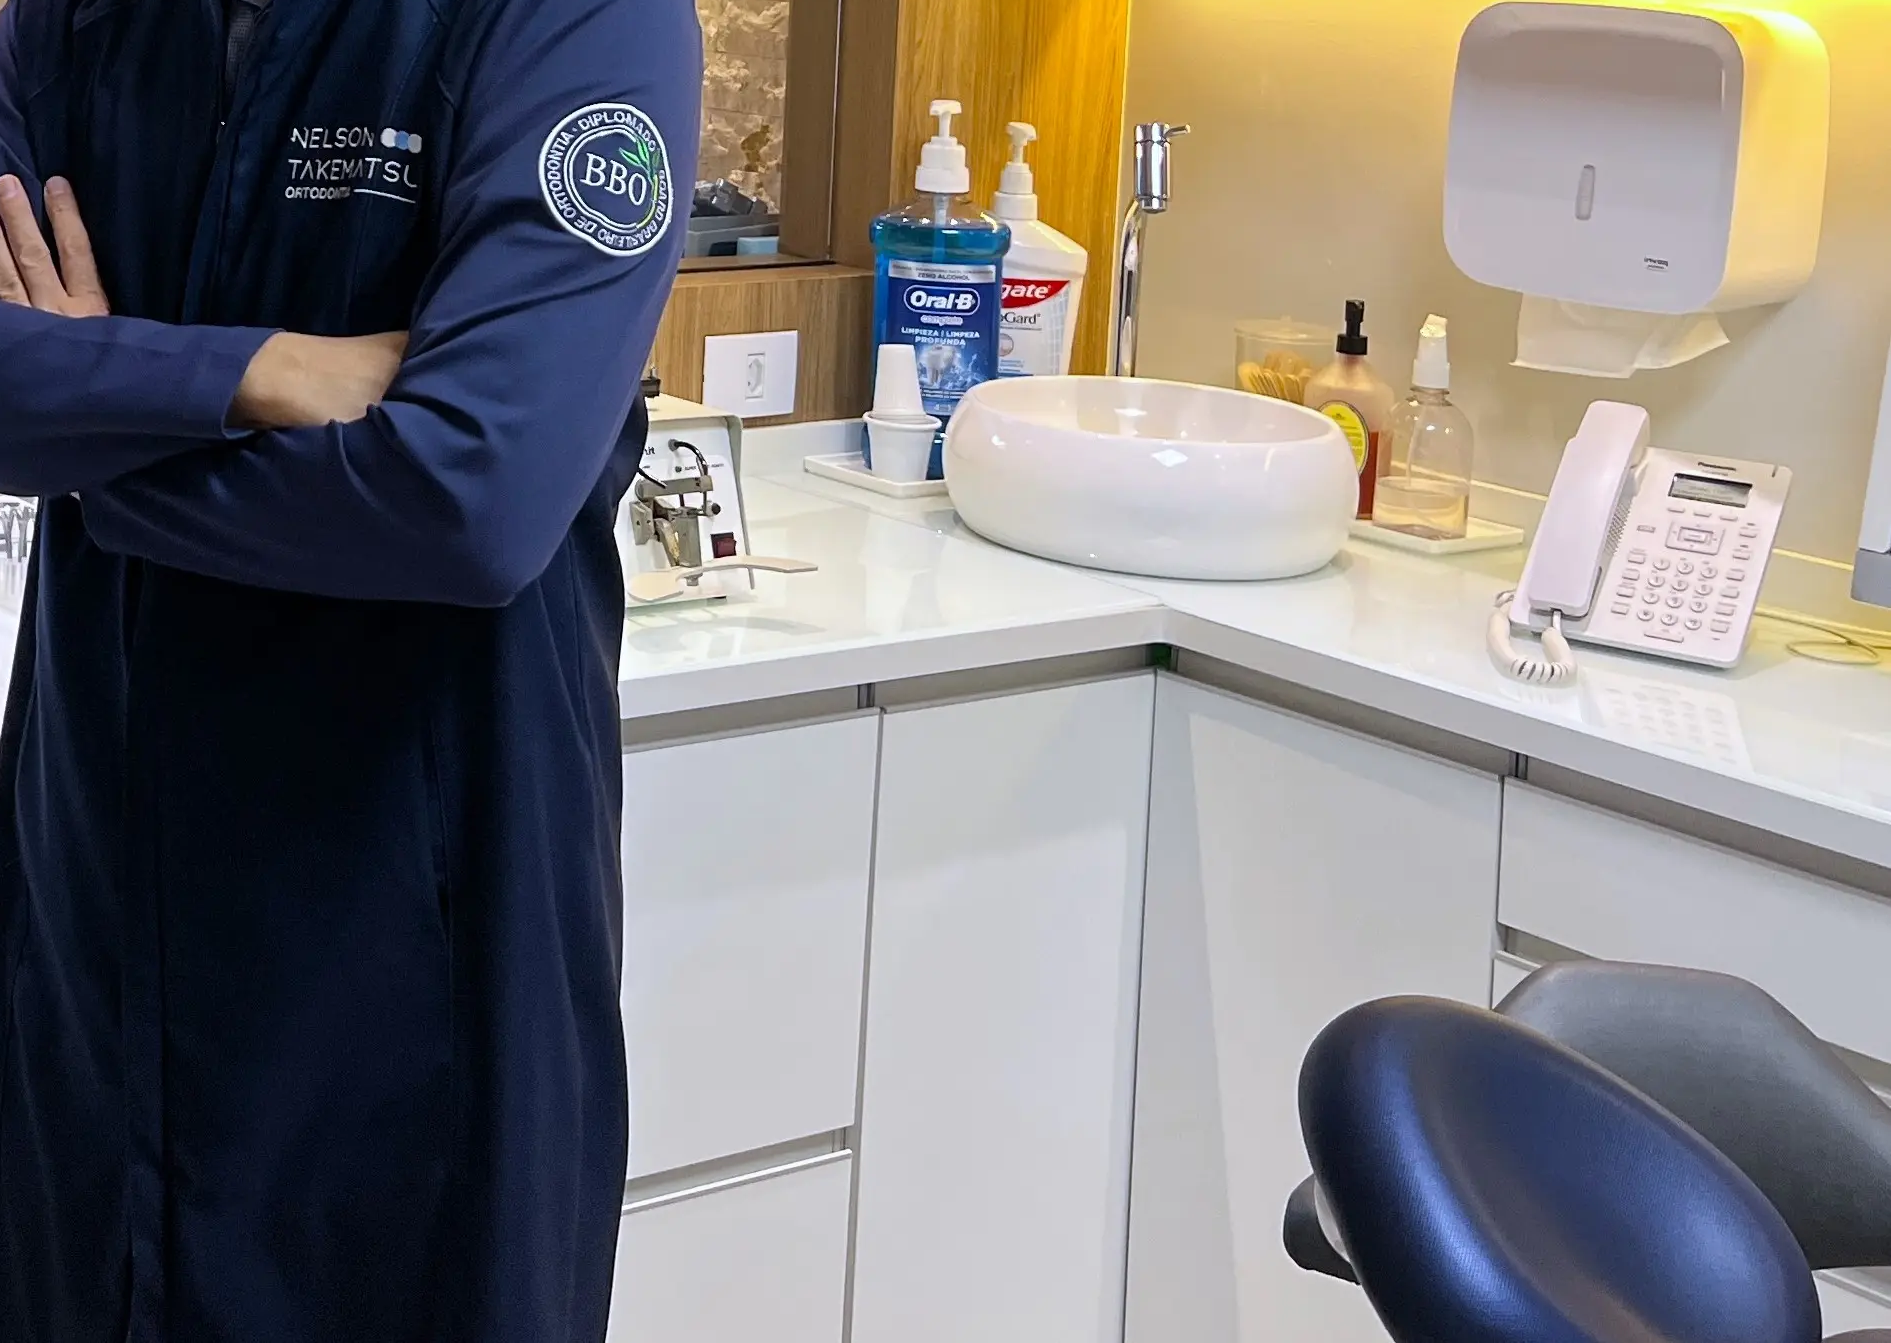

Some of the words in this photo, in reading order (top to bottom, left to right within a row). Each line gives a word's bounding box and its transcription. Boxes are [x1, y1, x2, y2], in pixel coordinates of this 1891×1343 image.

[290, 127, 375, 148] NELSON
[578, 111, 657, 151] DIPLOMADO
[546, 131, 577, 219] ORTODONTIA
[580, 153, 648, 206] BBO
[573, 215, 598, 234] DE
[910, 290, 973, 310] Oral-B
[901, 326, 939, 337] LIMPIEZA
[945, 329, 980, 339] LIMPEZA
[914, 336, 966, 346] PROFUNDA
